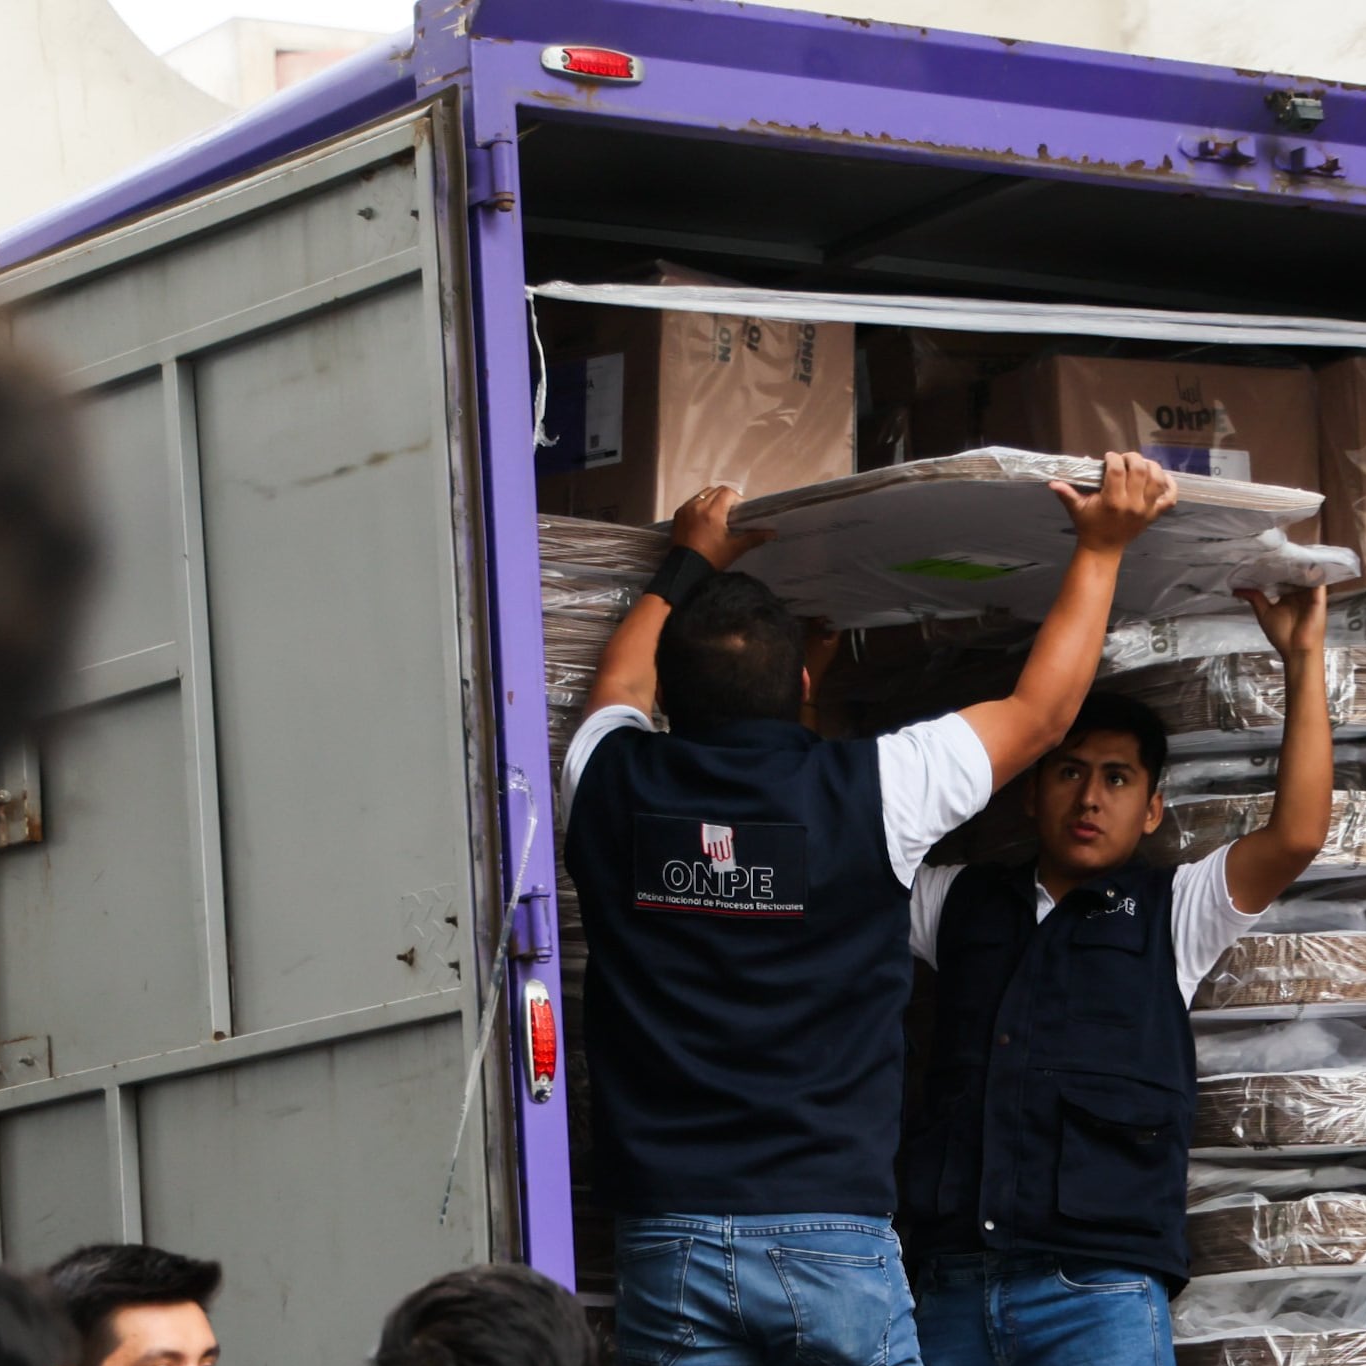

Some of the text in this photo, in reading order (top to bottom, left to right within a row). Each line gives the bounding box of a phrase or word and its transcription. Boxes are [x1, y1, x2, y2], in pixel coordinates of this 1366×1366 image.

[1155, 405, 1228, 433] ONPE
[662, 860, 774, 900] ONPE
[703, 896, 715, 907] de
[715, 899, 755, 911] Procesos
[756, 901, 804, 911] Electorales
